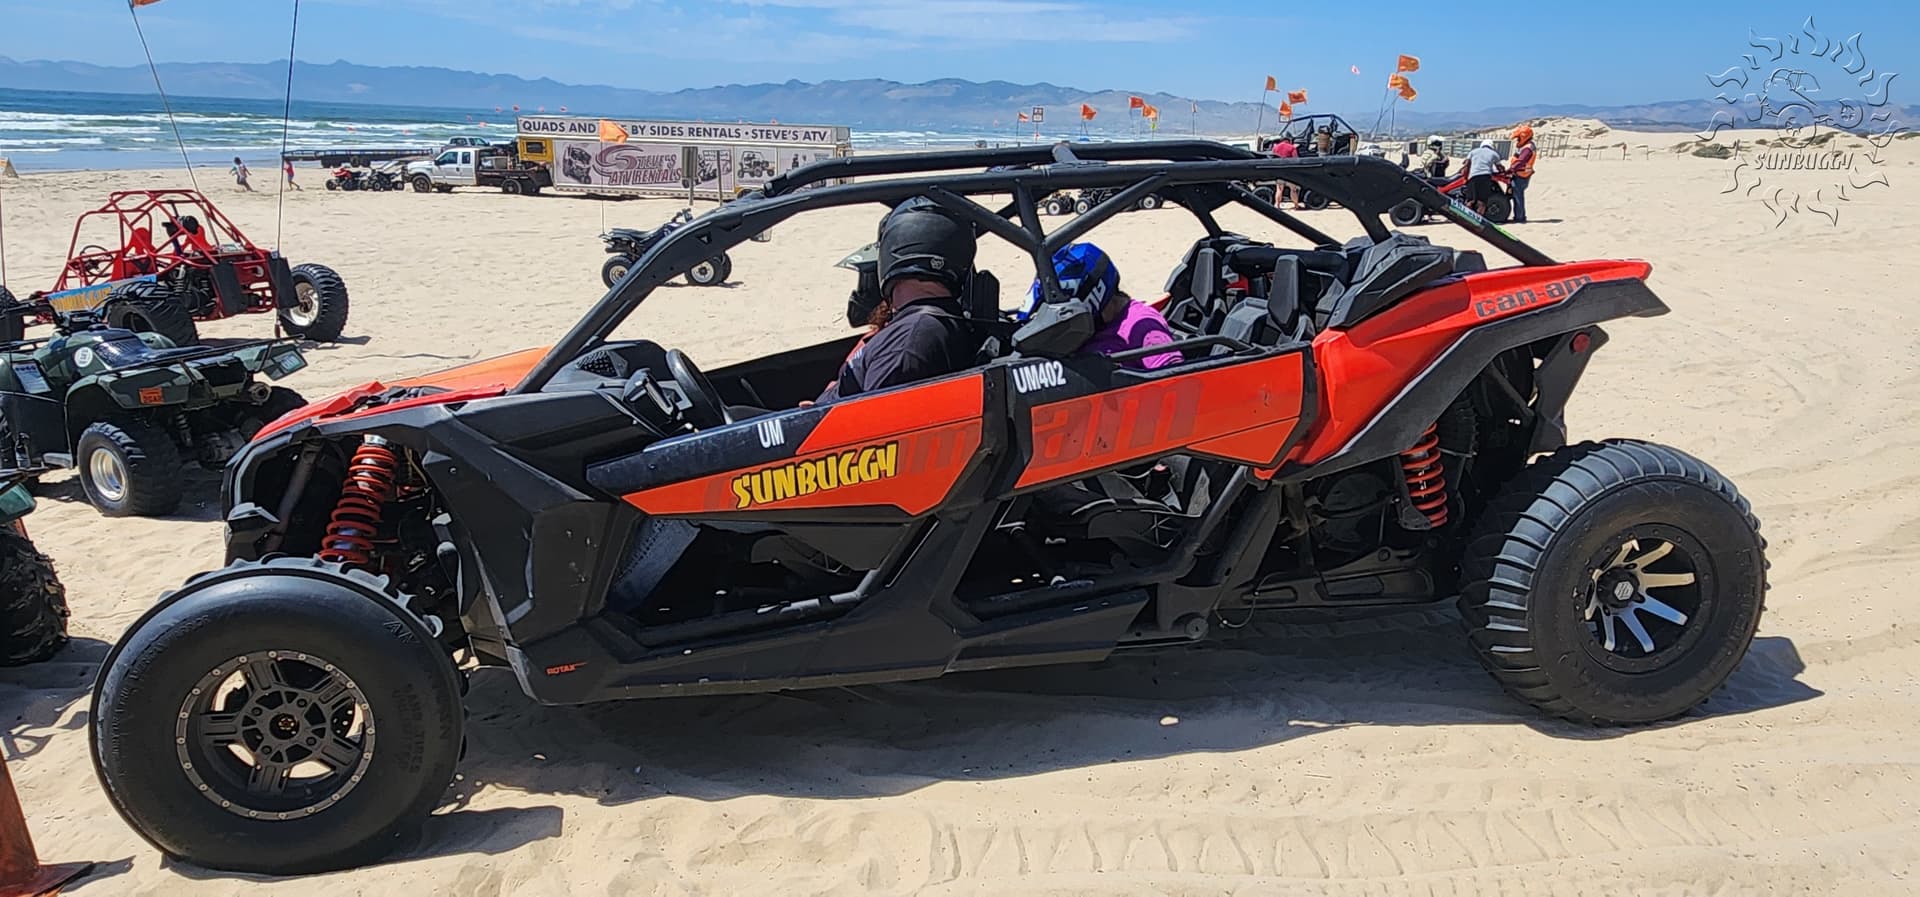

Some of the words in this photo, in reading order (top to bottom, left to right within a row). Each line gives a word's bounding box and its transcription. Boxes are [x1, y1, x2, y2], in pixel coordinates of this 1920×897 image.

[523, 121, 566, 133] QUADS
[568, 122, 597, 134] AND
[631, 125, 647, 136] BY
[650, 125, 684, 137] SIDES
[688, 127, 742, 139] RENTALS
[751, 128, 799, 141] STEVE'S
[802, 130, 828, 142] ATV
[1012, 360, 1067, 393] UM402
[756, 419, 785, 449] UM
[731, 441, 899, 511] SUNBUGGY
